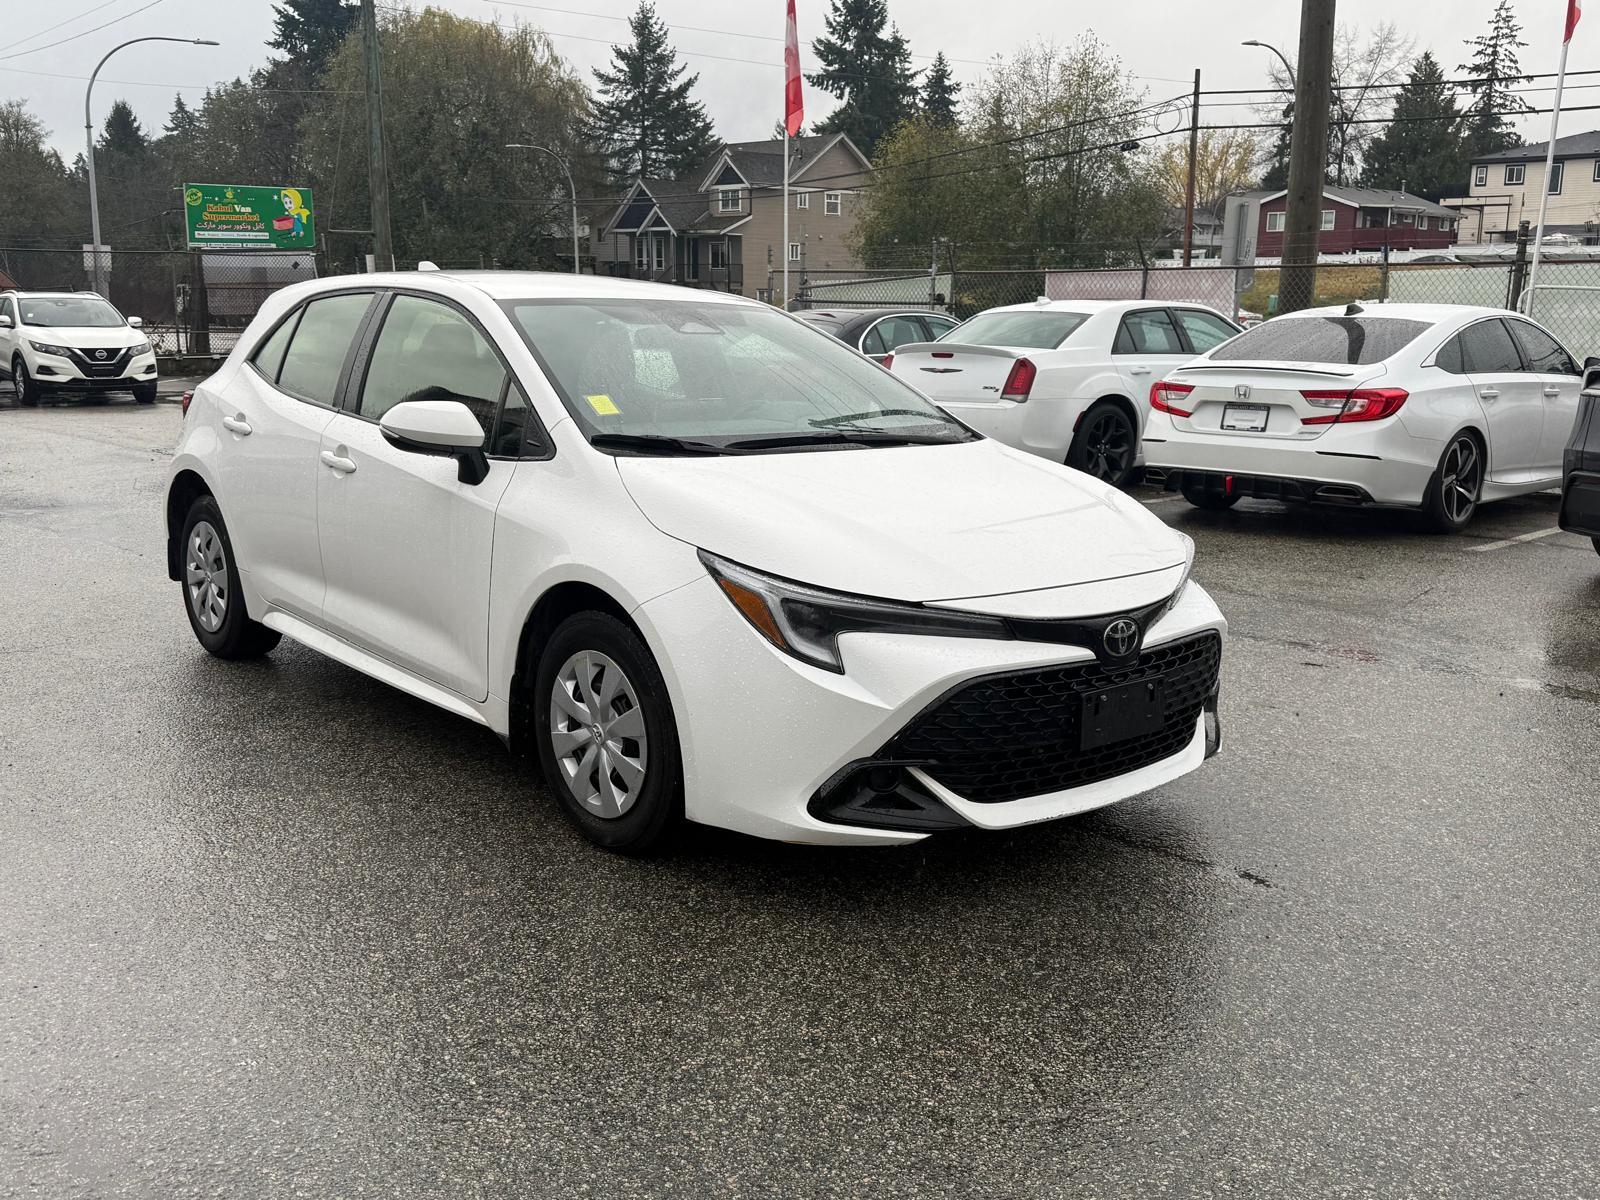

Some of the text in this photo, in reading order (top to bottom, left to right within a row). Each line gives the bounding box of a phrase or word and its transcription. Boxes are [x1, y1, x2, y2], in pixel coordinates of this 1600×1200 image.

[207, 204, 252, 213] Kabul Van
[203, 212, 260, 222] Supermarket
